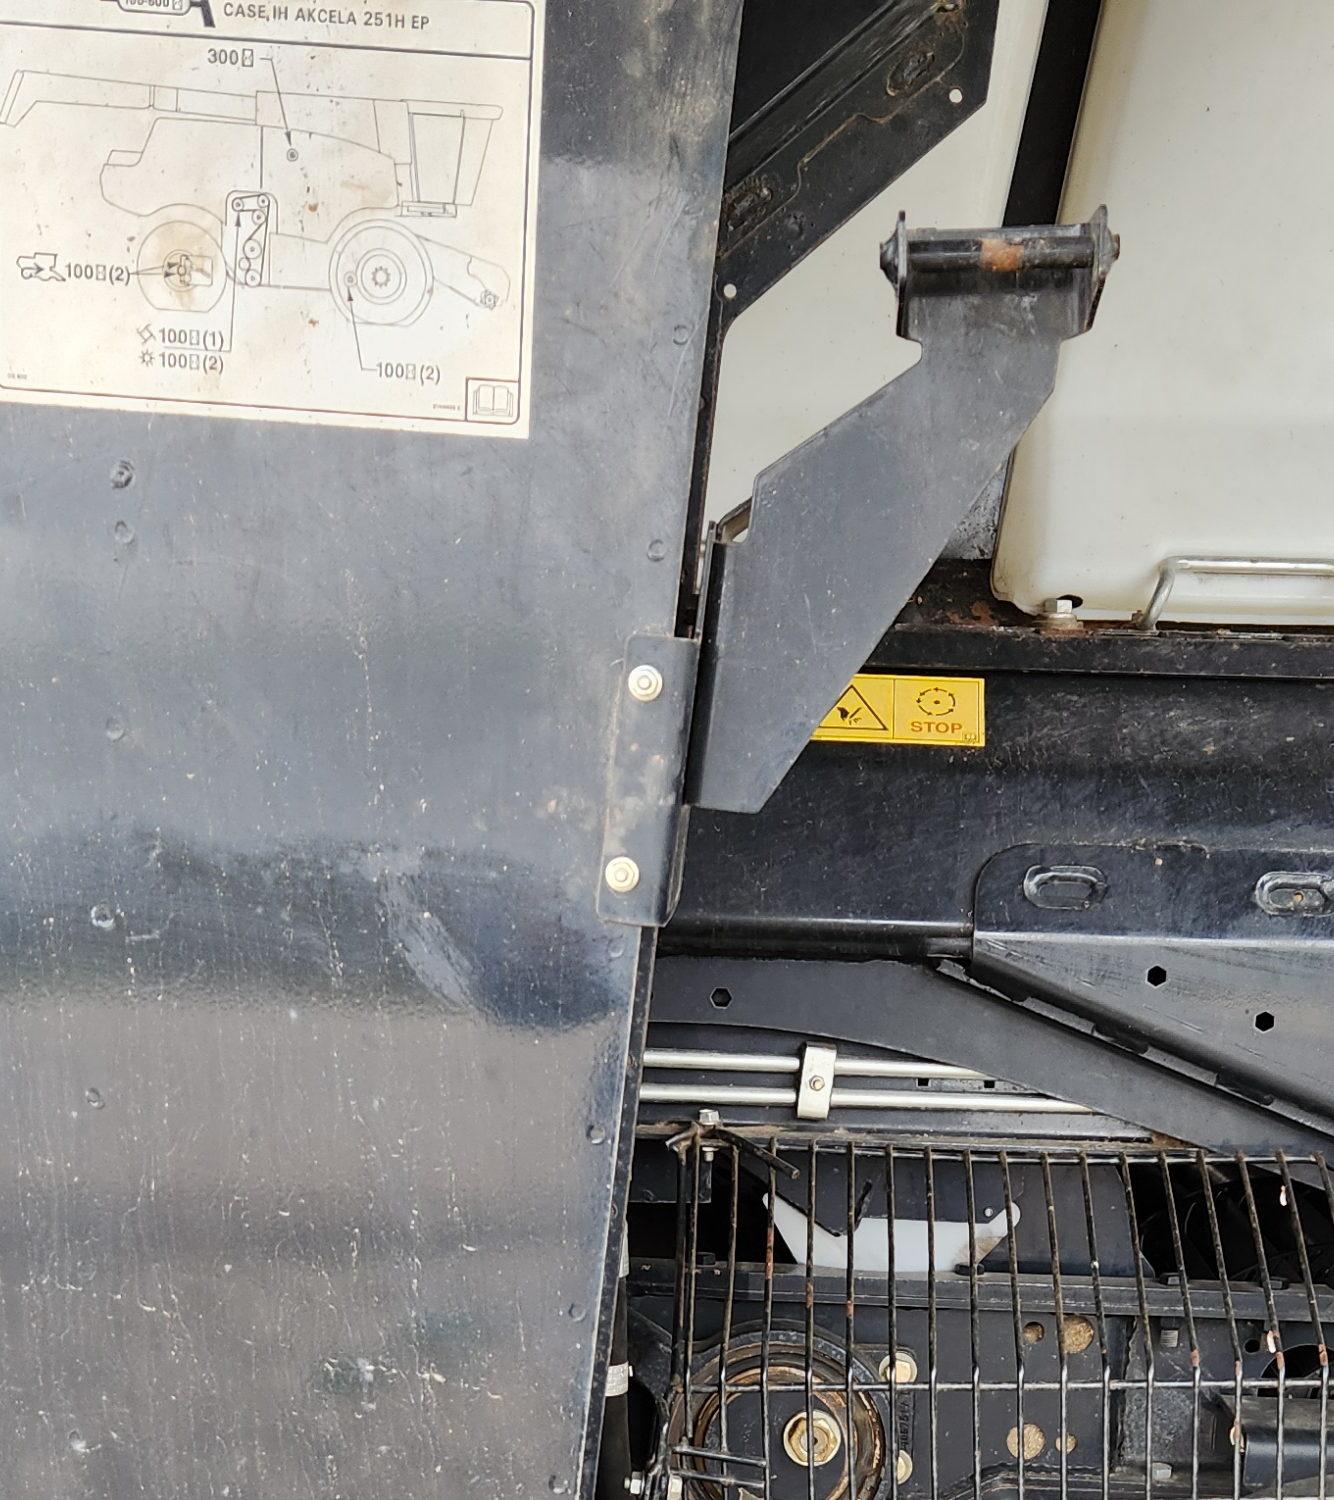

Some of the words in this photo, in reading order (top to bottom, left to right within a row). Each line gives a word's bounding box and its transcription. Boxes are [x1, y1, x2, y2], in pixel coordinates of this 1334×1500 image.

[223, 2, 266, 19] CASE
[273, 5, 288, 21] IH
[295, 7, 357, 26] AKCELA
[363, 11, 405, 29] 251H
[411, 15, 430, 30] EP
[207, 48, 239, 65] 300
[65, 262, 94, 280] 100
[158, 327, 187, 344] 100
[158, 351, 187, 368] 100
[376, 362, 404, 379] 100
[910, 721, 963, 734] STOP
